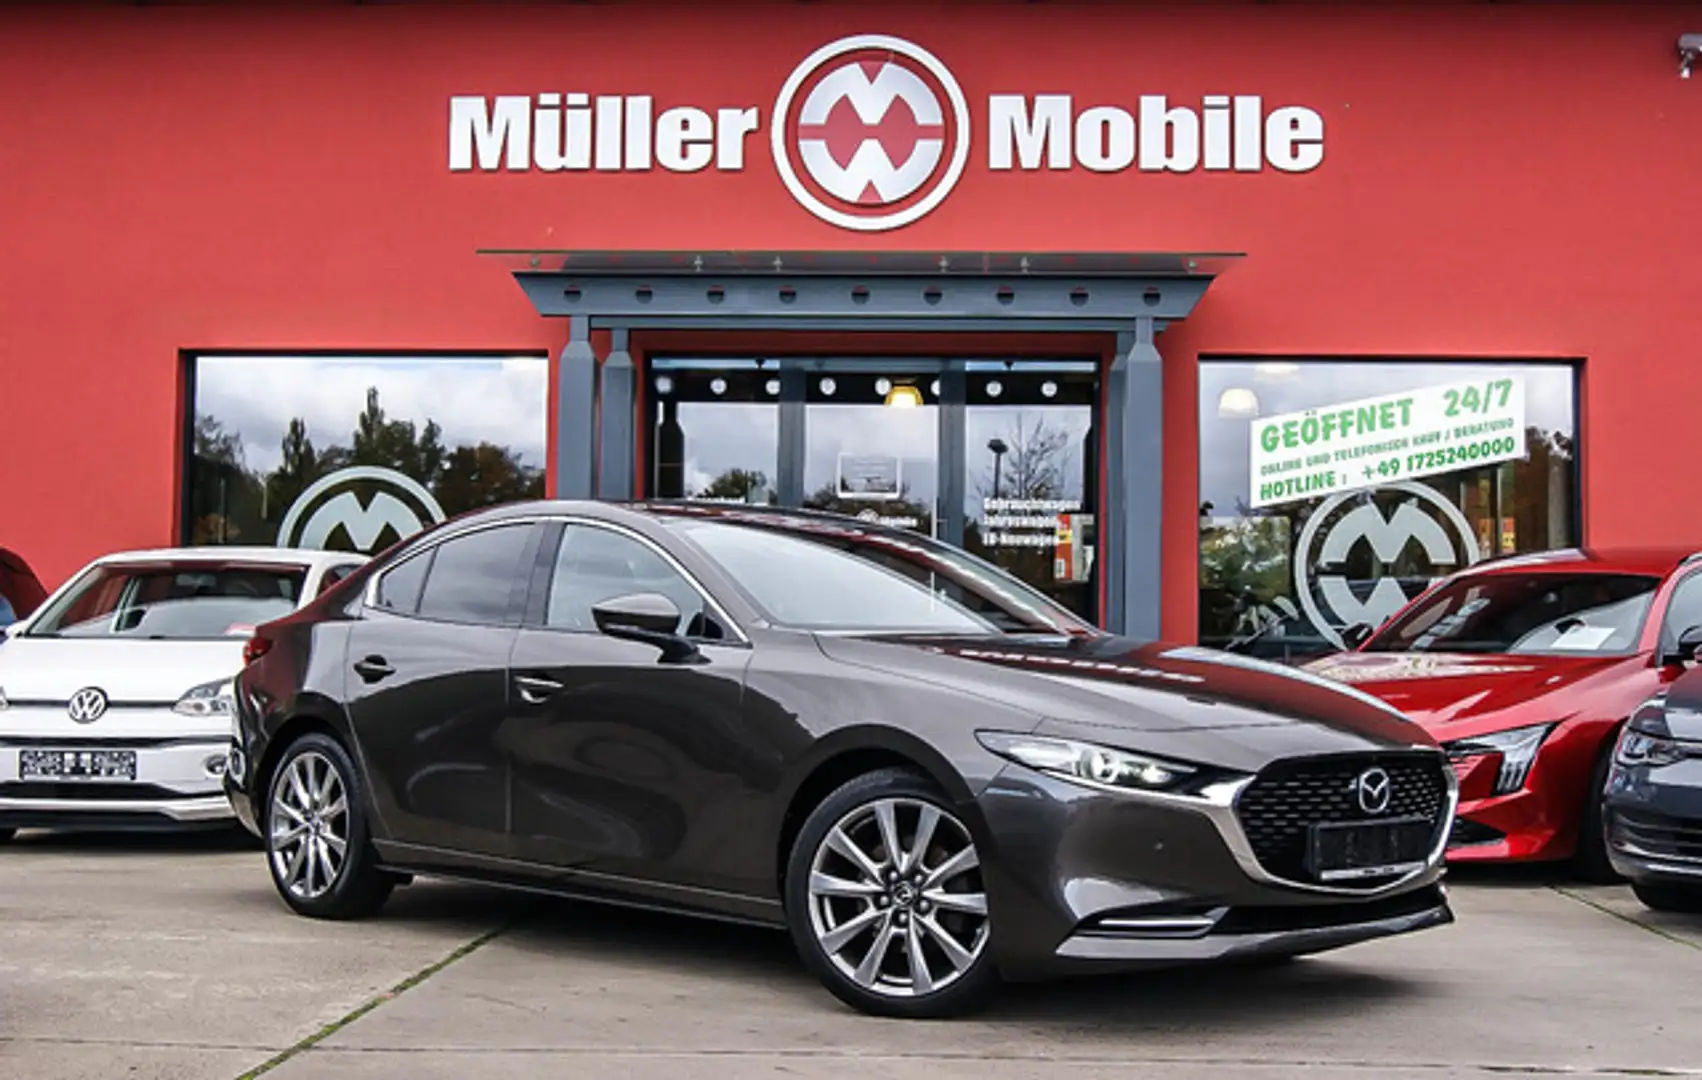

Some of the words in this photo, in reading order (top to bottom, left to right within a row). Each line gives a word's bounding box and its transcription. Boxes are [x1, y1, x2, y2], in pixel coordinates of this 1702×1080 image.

[449, 94, 758, 171] Müller
[989, 94, 1325, 172] Mobile
[1260, 397, 1414, 453] GEÖFFNET
[1443, 378, 1513, 417] 24/7
[1260, 458, 1302, 476] ONLINE
[1306, 452, 1332, 467] UND
[1334, 438, 1409, 462] TELEFONISCH
[1412, 431, 1441, 447] KAUF
[1453, 418, 1515, 439] BERATUNG
[1260, 471, 1336, 500] HOTLINE
[1362, 458, 1401, 479] +49
[1407, 437, 1515, 472] 1725240000
